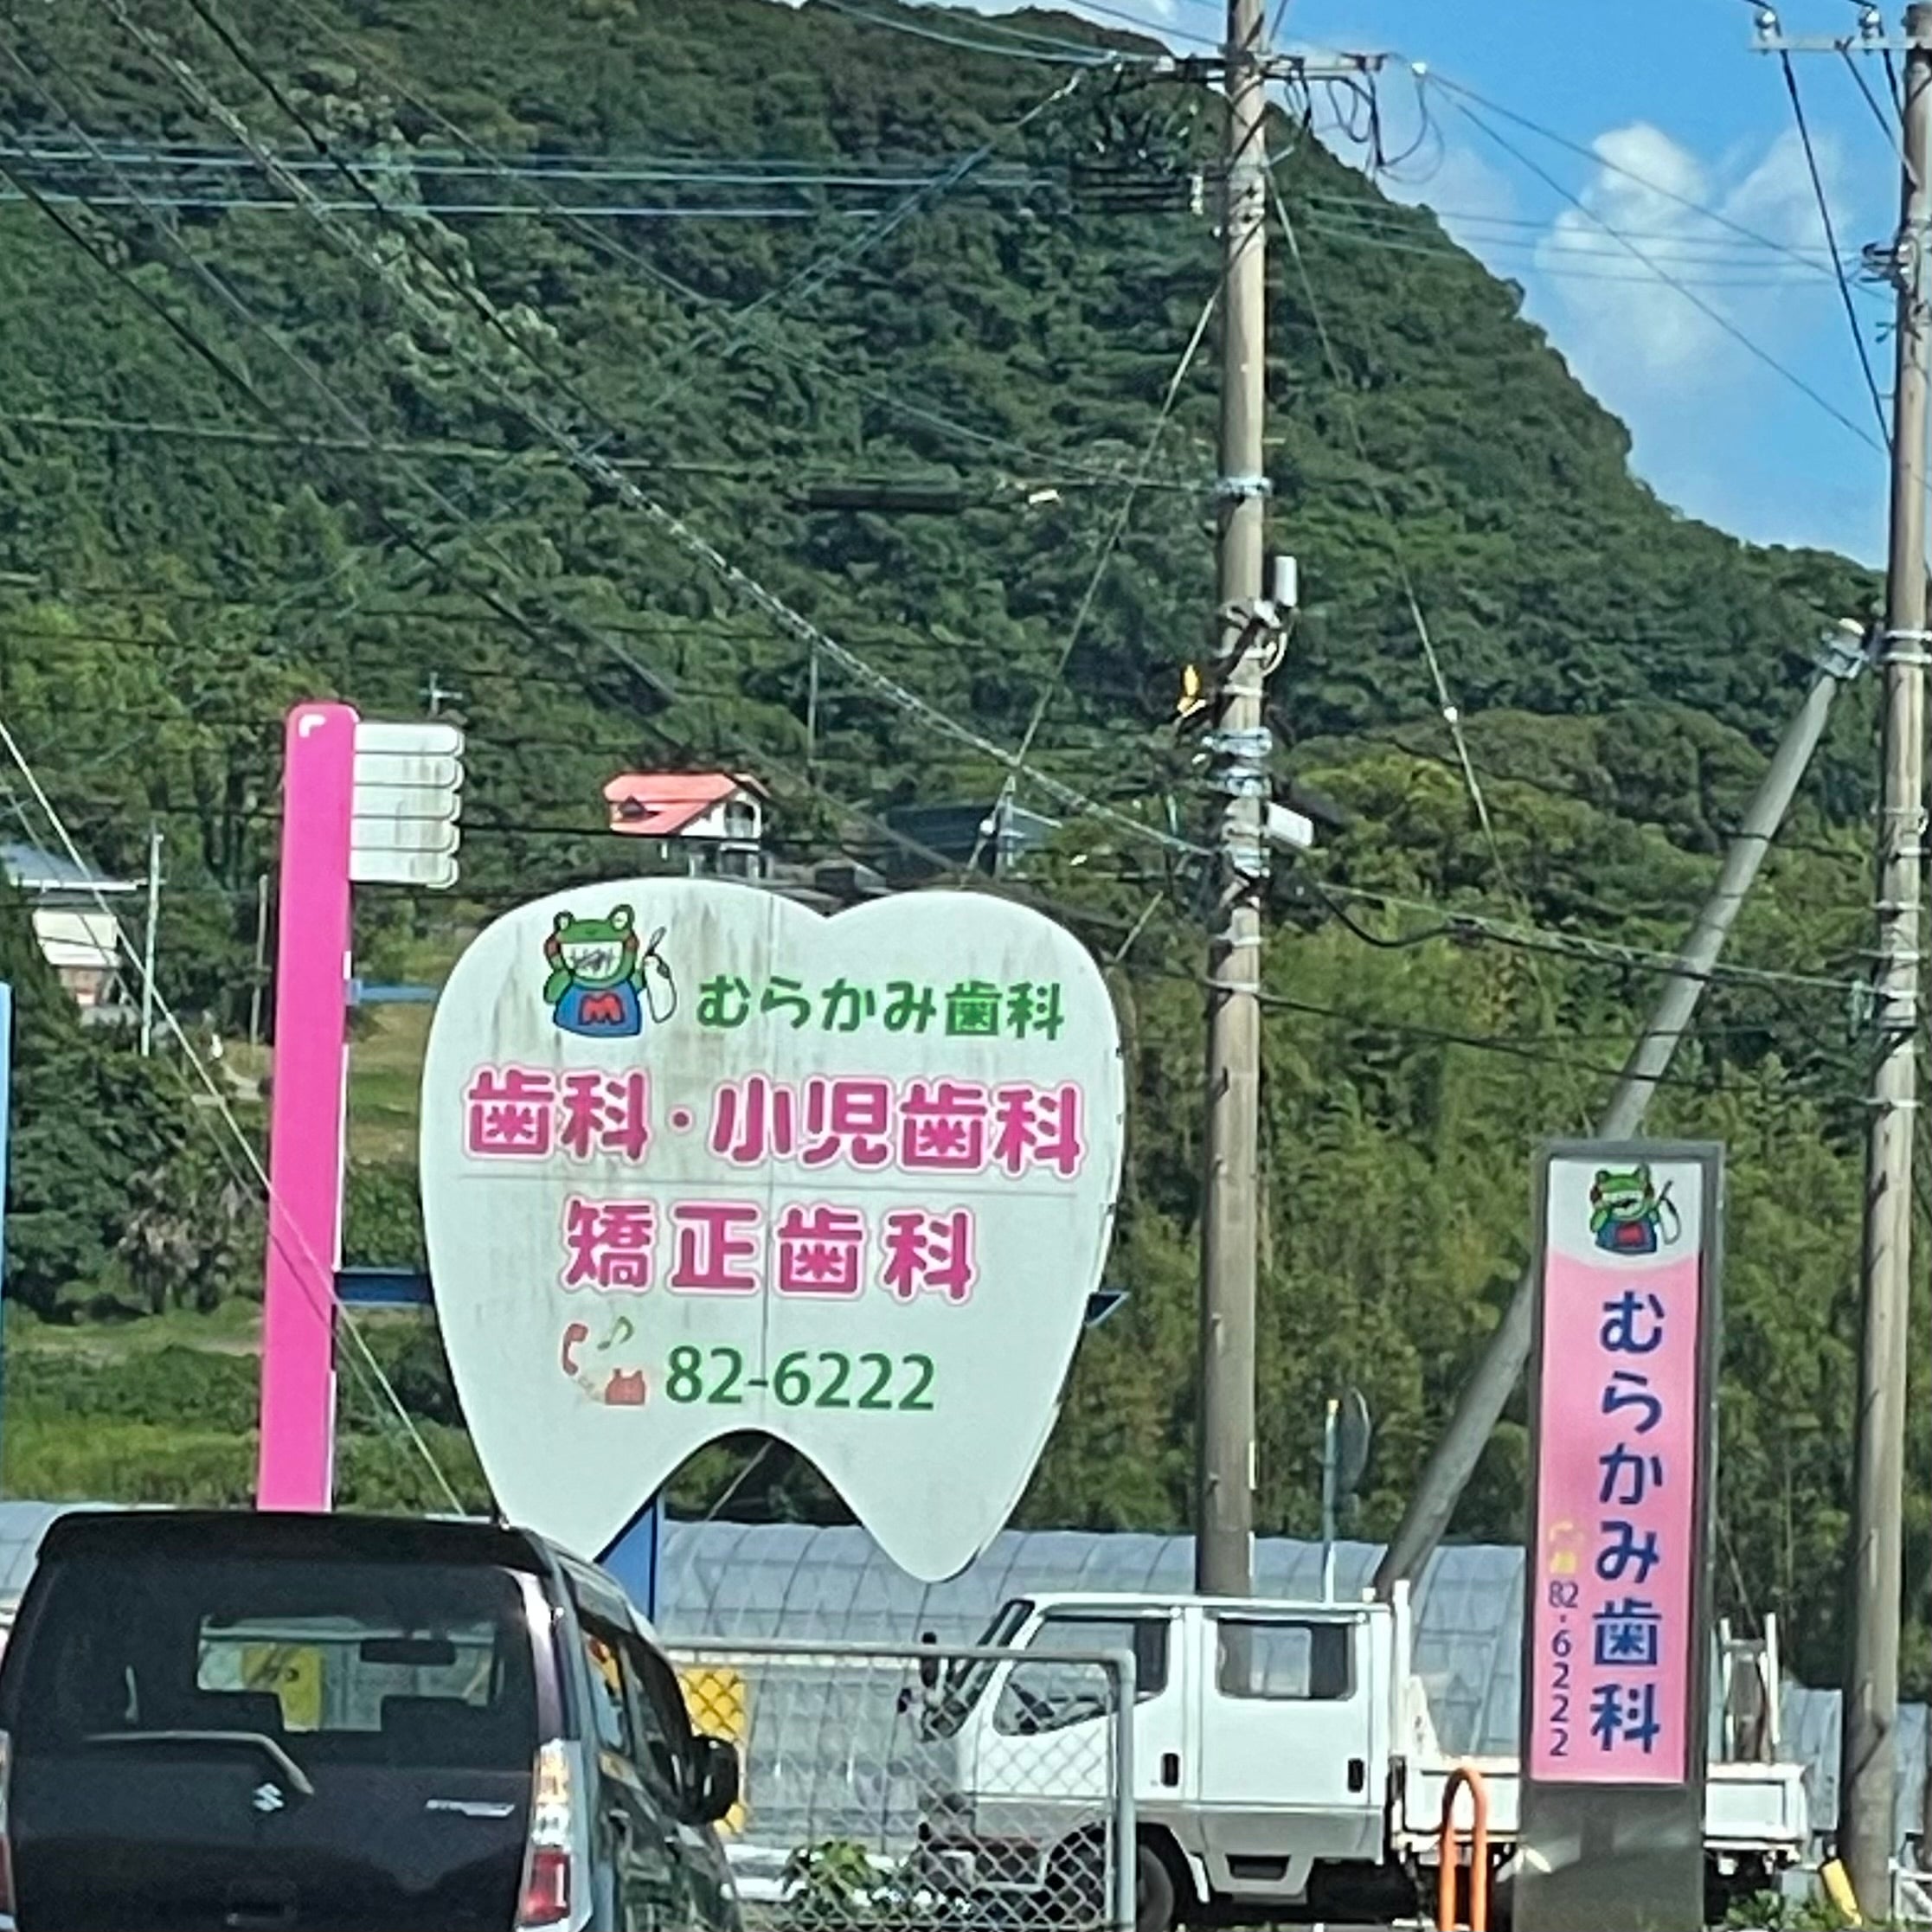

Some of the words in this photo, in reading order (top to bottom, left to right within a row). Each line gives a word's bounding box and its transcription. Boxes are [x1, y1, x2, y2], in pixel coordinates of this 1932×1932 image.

[696, 973, 1065, 1041] むらかみ歯科
[464, 1068, 1084, 1173] 歯科・小児歯科
[561, 1196, 973, 1301] 矯正歯科
[664, 1345, 936, 1410] 82-6222
[1590, 1290, 1666, 1754] むらかみ歯科
